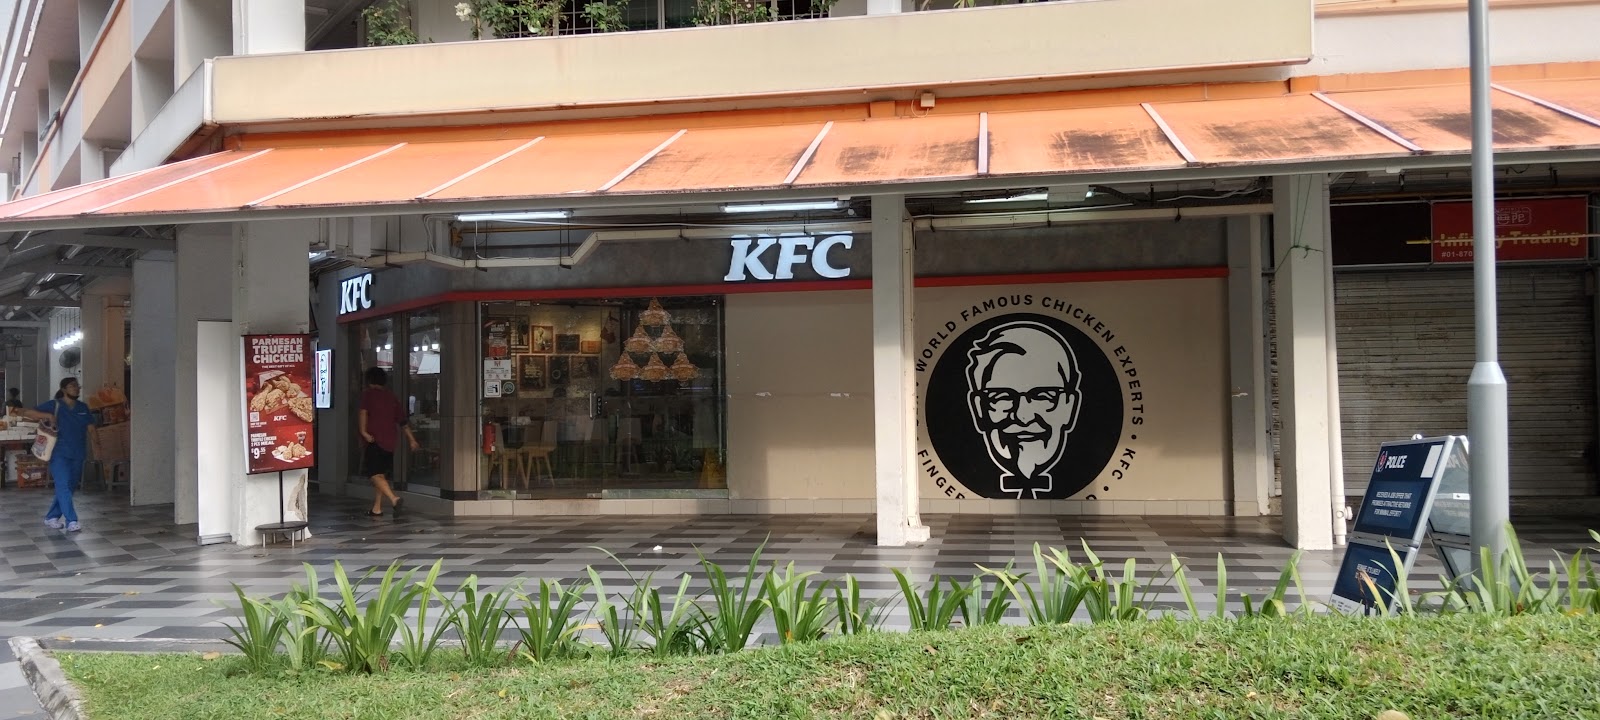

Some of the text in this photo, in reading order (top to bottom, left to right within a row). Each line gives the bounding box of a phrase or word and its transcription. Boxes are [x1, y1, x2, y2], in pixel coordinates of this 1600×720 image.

[1440, 230, 1580, 249] Infiy Trading
[724, 232, 853, 282] KFC
[1441, 250, 1473, 258] #01-870
[340, 273, 373, 315] KFC
[252, 337, 303, 346] PARMESAN
[252, 345, 303, 354] TRUFFLE
[253, 354, 304, 364] CHICKEN
[915, 294, 1144, 426] WORLD FAMOUS CHICKEN EXPERTS
[1112, 447, 1136, 481] KFC
[1385, 455, 1407, 469] POLICE
